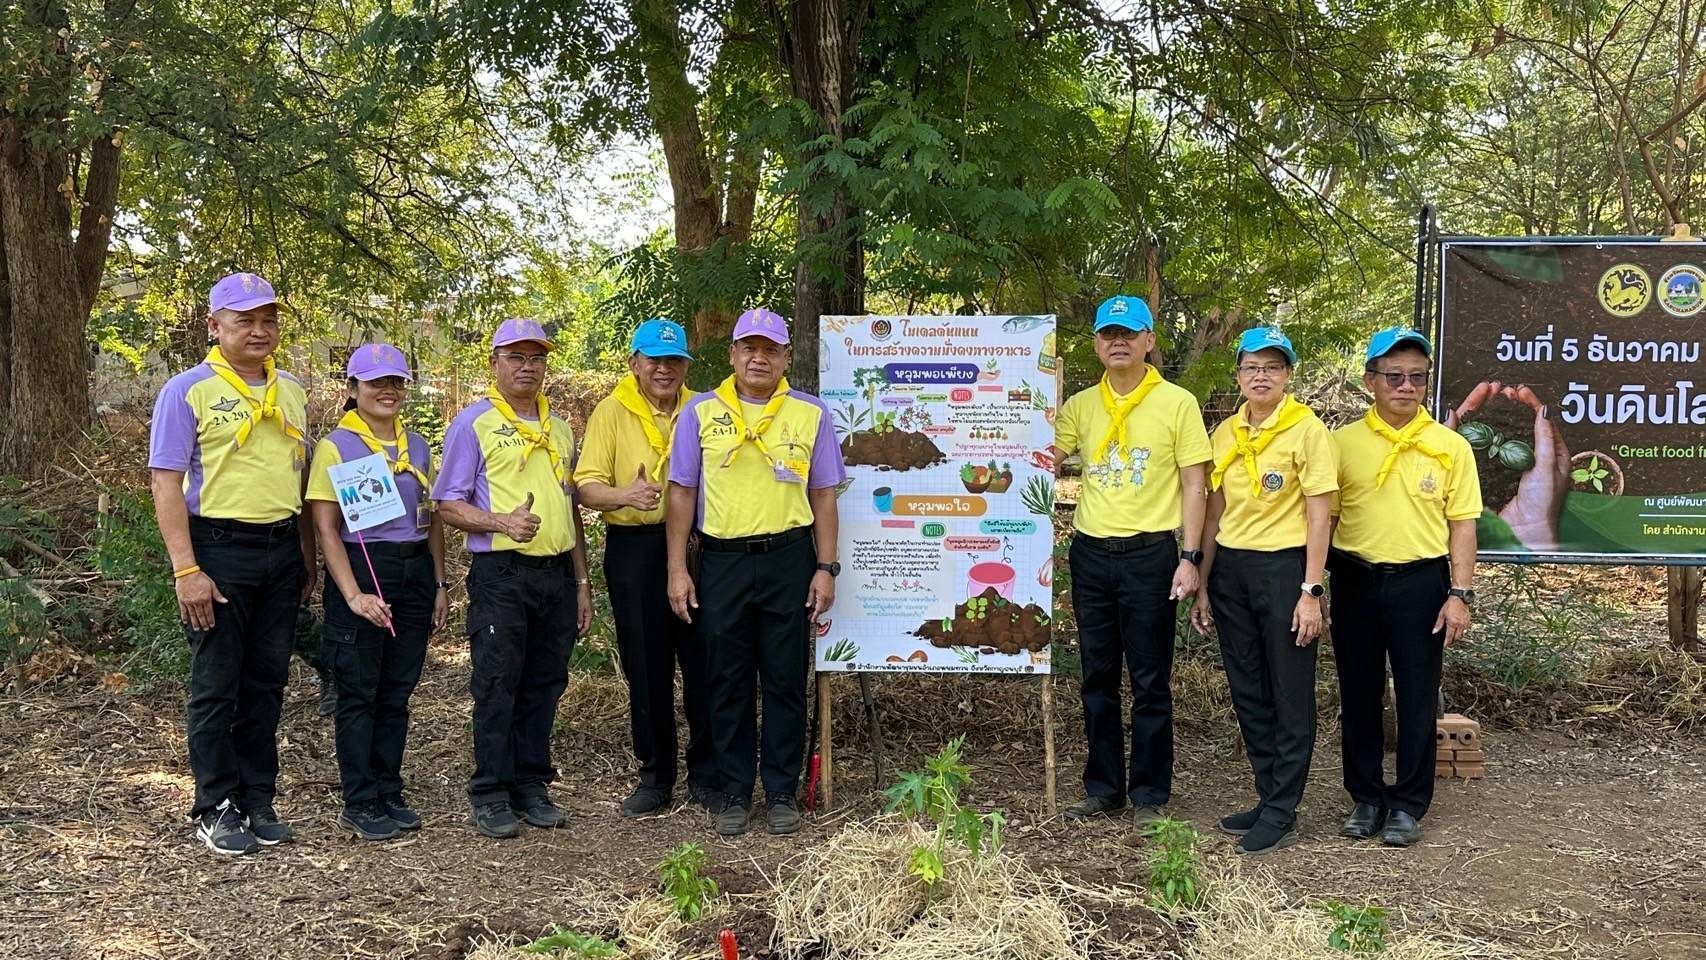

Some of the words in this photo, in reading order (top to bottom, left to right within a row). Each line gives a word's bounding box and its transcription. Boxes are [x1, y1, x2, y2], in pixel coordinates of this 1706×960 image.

[1496, 325, 1553, 362] วันที่
[1561, 339, 1580, 362] 5
[1587, 334, 1699, 362] ธันวาคม
[894, 366, 975, 384] หลุมพอเพียง
[1611, 444, 1658, 458] “Great
[1662, 444, 1694, 458] food
[340, 475, 392, 507] MOI
[907, 497, 970, 515] หลุมพอใจ
[1644, 498, 1654, 507] ณ
[925, 525, 942, 536] NOTES
[1643, 523, 1660, 535] โดย
[1663, 524, 1706, 535] สำนักงาน
